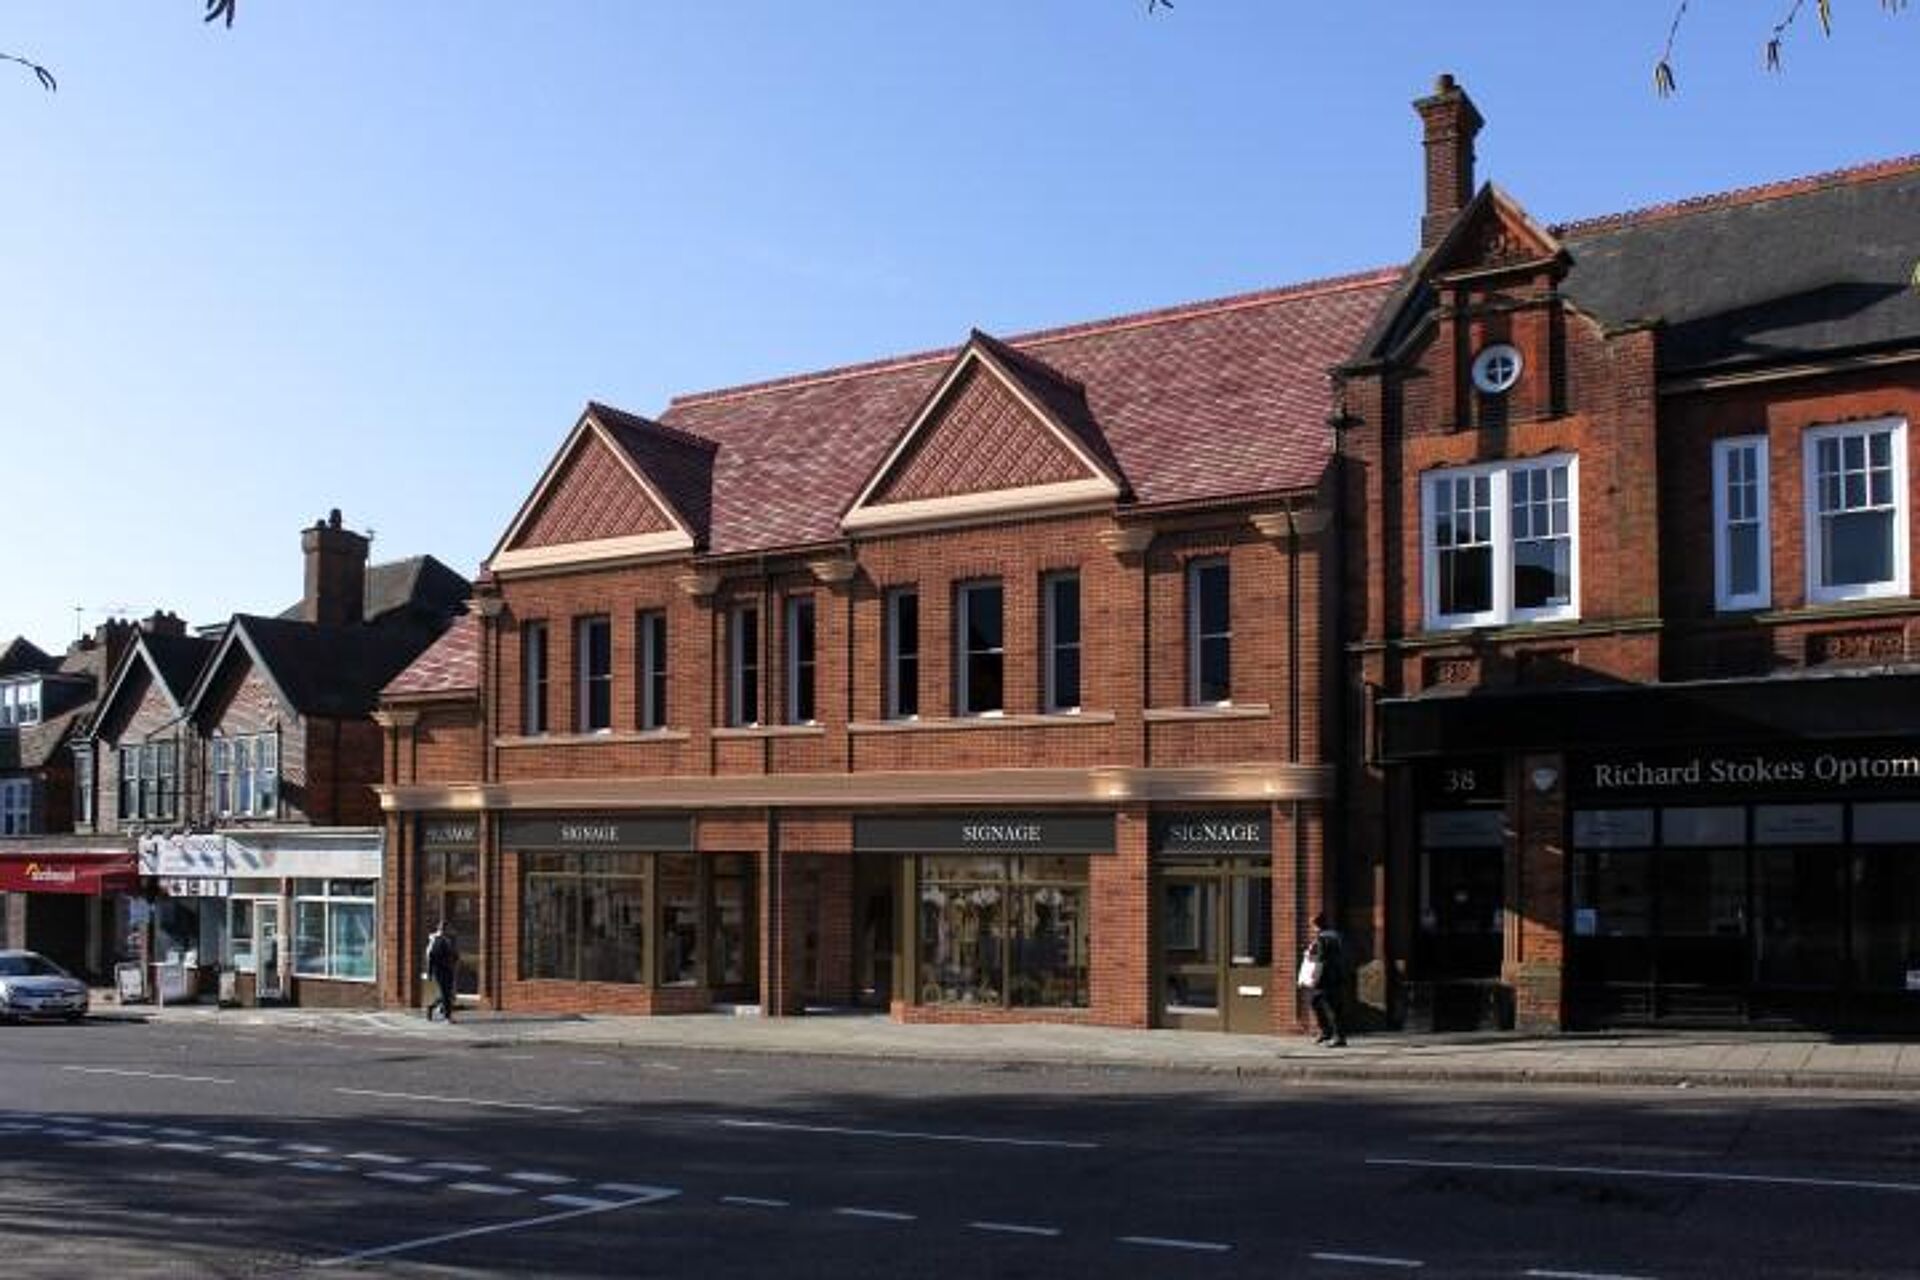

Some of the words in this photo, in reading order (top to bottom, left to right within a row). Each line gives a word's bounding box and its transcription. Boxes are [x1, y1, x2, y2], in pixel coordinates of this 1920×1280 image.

[1594, 759, 1700, 787] Richard
[1710, 757, 1804, 782] Stokes
[1814, 754, 1919, 784] Optom
[1448, 768, 1476, 792] 38
[561, 825, 620, 841] SIGNAGE
[963, 825, 1041, 841] SIGNAGE
[1169, 823, 1260, 841] SIGNAGE
